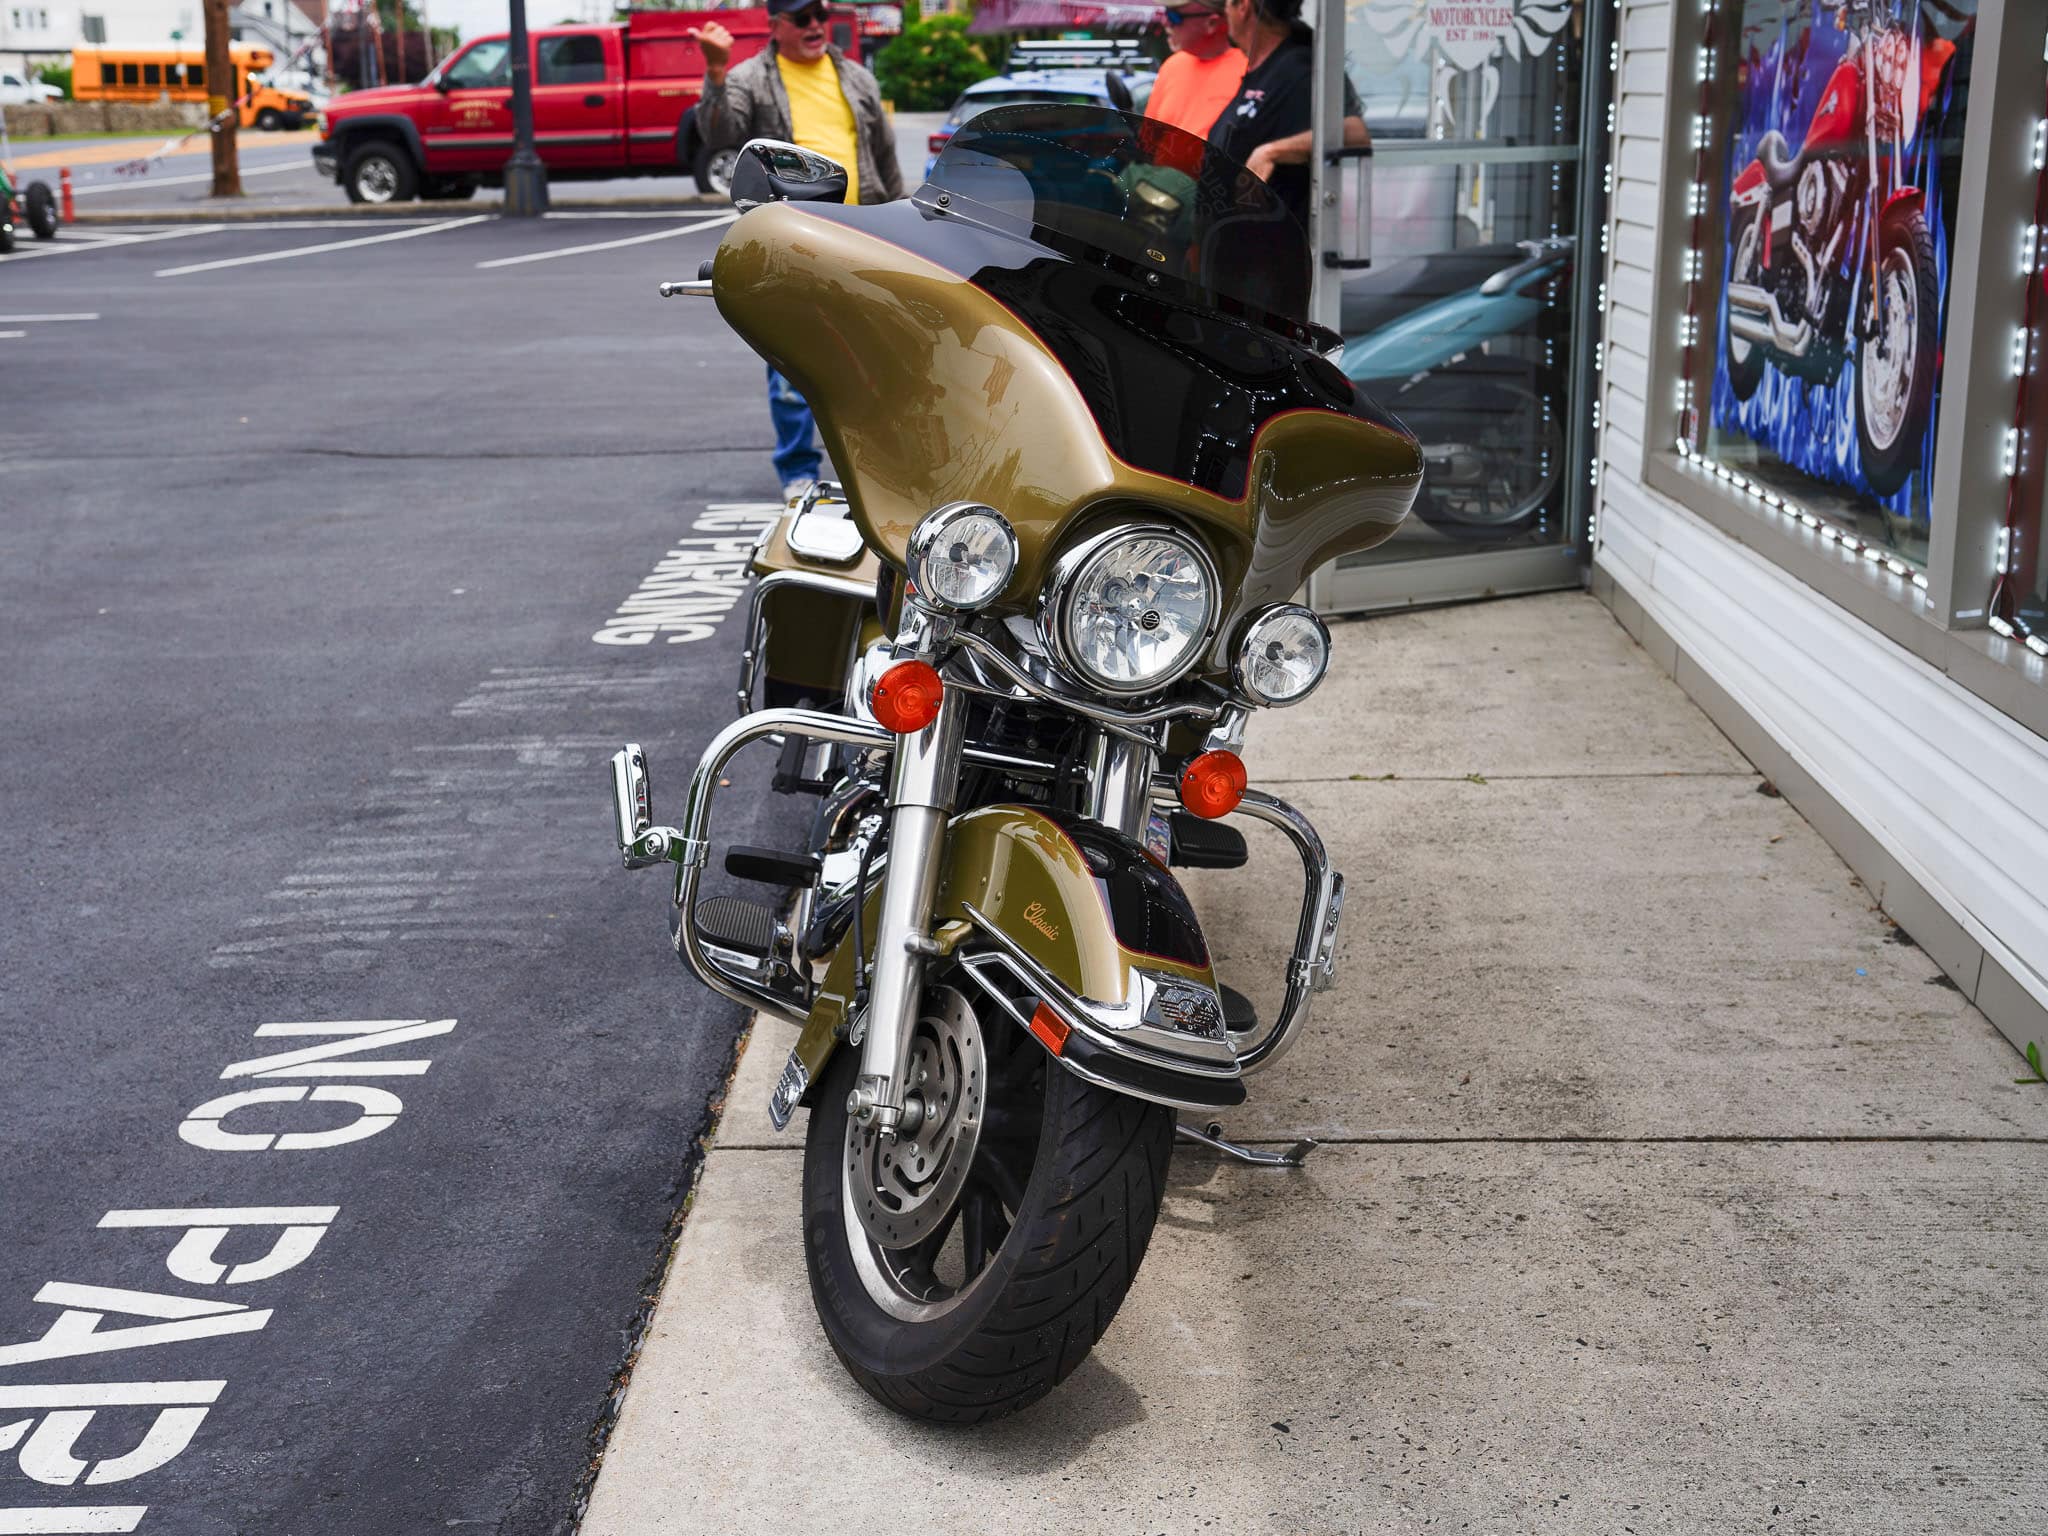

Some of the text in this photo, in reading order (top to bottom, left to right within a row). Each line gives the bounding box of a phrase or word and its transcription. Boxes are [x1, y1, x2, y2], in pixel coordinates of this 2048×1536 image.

[1430, 7, 1513, 26] MOTORCYCLES
[1023, 901, 1059, 941] Classic
[178, 1018, 458, 1151] NO
